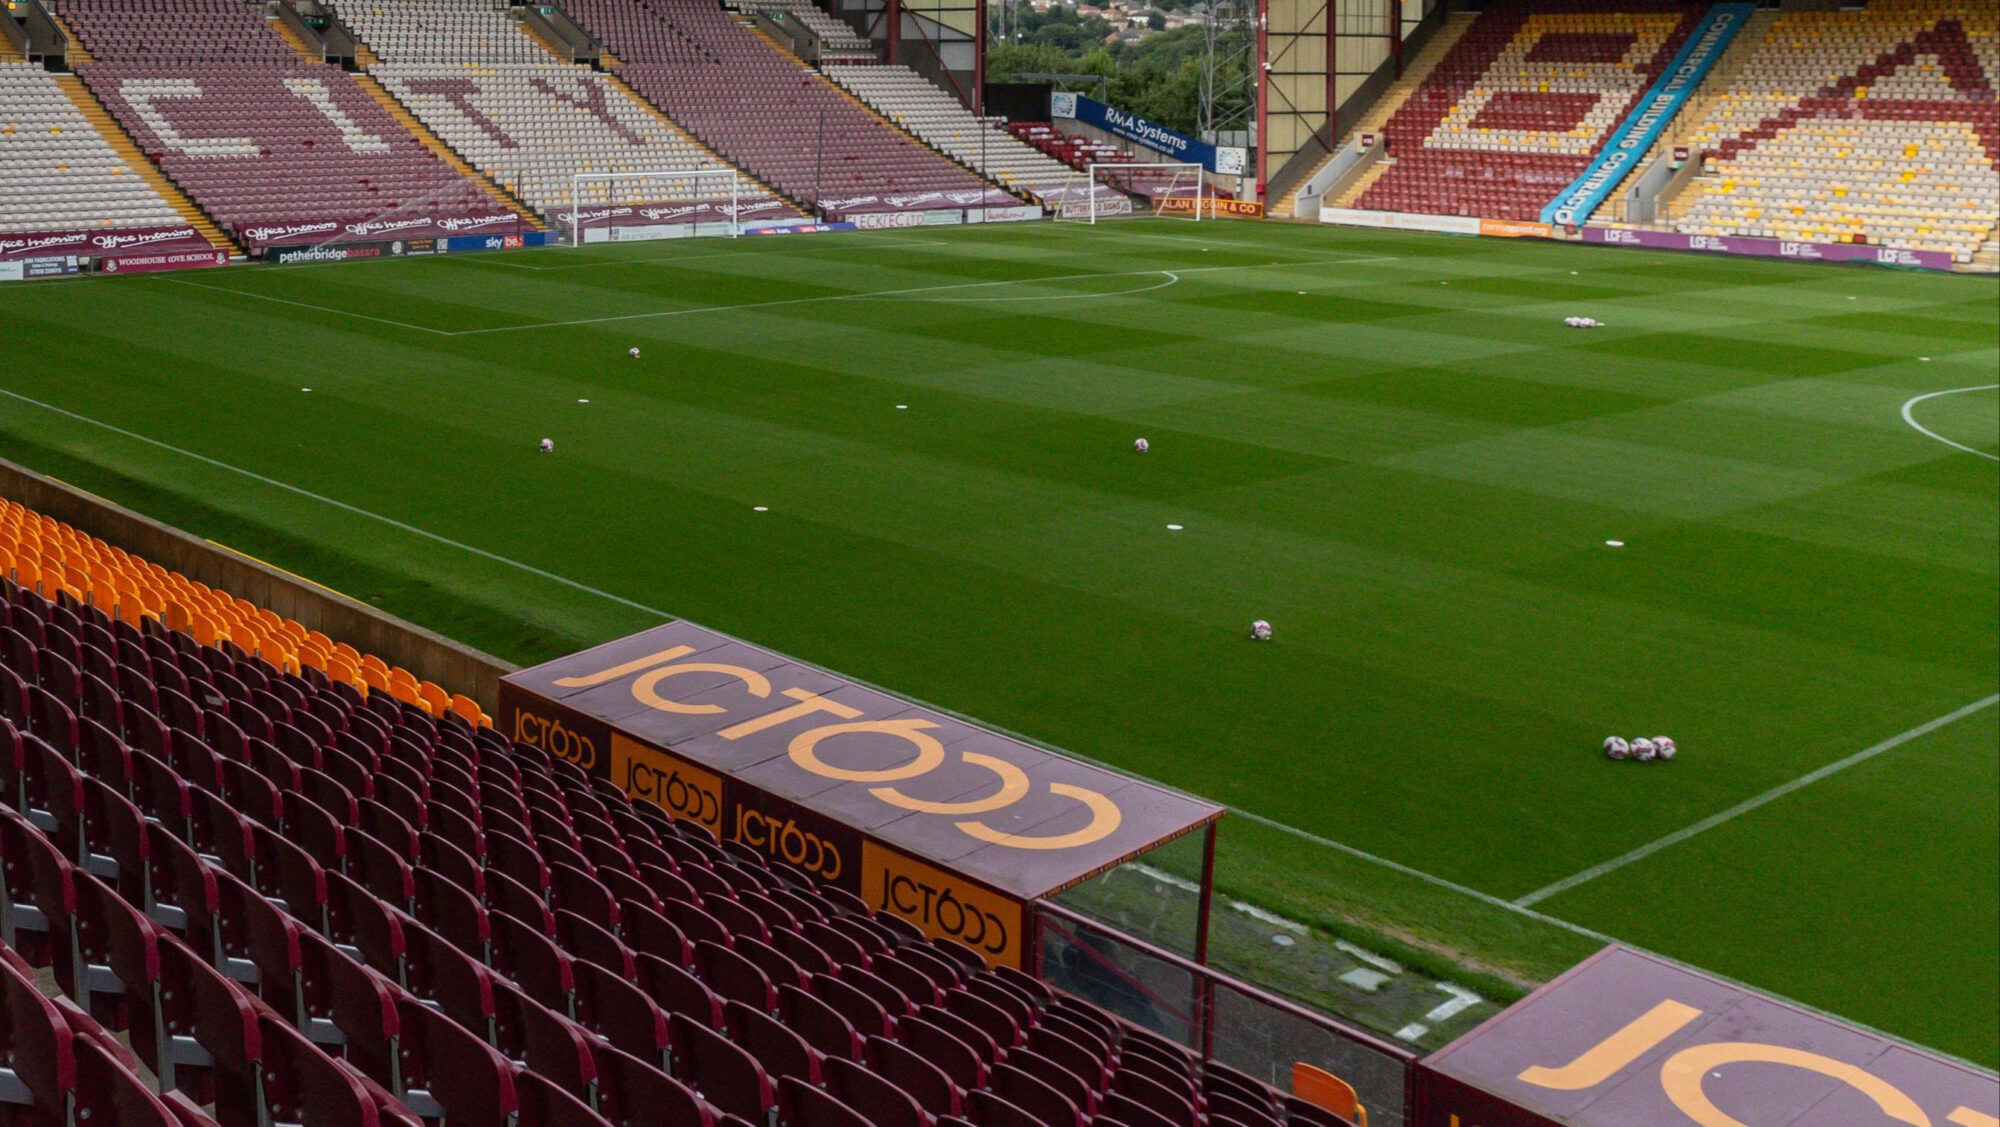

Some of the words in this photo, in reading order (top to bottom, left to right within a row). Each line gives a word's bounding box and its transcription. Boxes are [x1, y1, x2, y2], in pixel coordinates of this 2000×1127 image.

[1664, 13, 1734, 91] COMMERCIAL
[1105, 107, 1135, 131] RMA
[1135, 119, 1188, 151] Systems
[1620, 94, 1675, 149] BUILDING
[1163, 200, 1189, 209] ALAN
[1229, 203, 1237, 212] &
[1238, 203, 1256, 214] CO
[245, 226, 286, 241] Office
[286, 221, 338, 234] Interiors
[92, 234, 137, 249] Office
[485, 236, 504, 250] sky
[118, 256, 167, 266] WOODHOUSE
[186, 252, 215, 262] SCHOOL
